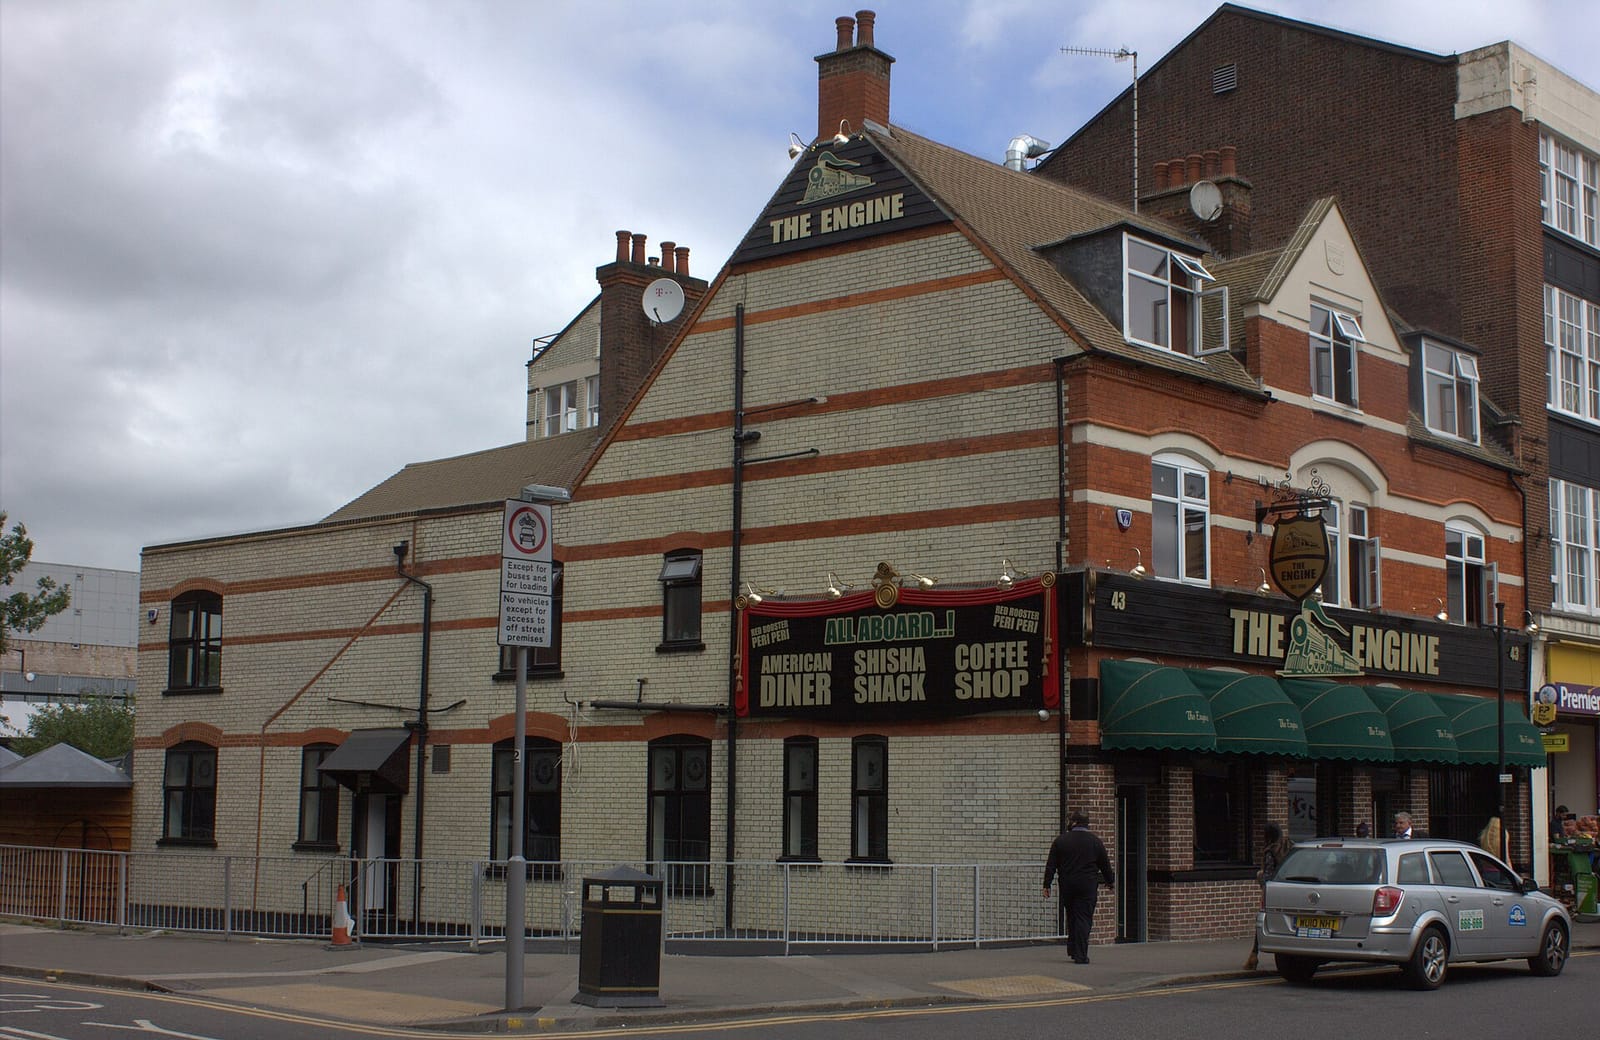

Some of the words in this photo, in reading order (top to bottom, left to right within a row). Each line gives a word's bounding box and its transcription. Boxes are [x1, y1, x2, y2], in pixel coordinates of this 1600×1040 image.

[770, 213, 812, 243] THE
[821, 193, 904, 234] ENGINE
[507, 561, 533, 572] Except
[536, 563, 547, 573] for
[1281, 569, 1317, 580] ENGINE
[507, 571, 531, 580] buses
[532, 573, 547, 583] and
[506, 581, 518, 590] for
[520, 582, 548, 593] loading
[503, 594, 515, 603] No
[518, 595, 549, 606] vehicles
[1111, 591, 1126, 610] 43
[506, 605, 533, 616] except
[535, 606, 546, 615] for
[506, 615, 534, 624] access
[537, 615, 546, 624] to
[995, 605, 1009, 616] RED
[1009, 607, 1040, 620] ROOSTER
[506, 624, 518, 632] off
[521, 625, 545, 634] street
[762, 620, 789, 634] ROOSTER
[824, 617, 856, 645] ALL
[993, 614, 1015, 630] PERI
[1016, 618, 1039, 634] PERI
[506, 634, 544, 644] premises
[752, 633, 770, 648] PERI
[771, 629, 790, 643] PERI
[1230, 608, 1285, 658] THE
[1352, 625, 1440, 676] ENGINE
[761, 653, 832, 674] AMERICAN
[854, 647, 926, 675] SHISHA
[955, 641, 1028, 671] COFFEE
[760, 672, 832, 707] DINER
[854, 673, 926, 704] SHACK
[954, 670, 1029, 700] SHOP
[1561, 686, 1600, 711] Premier
